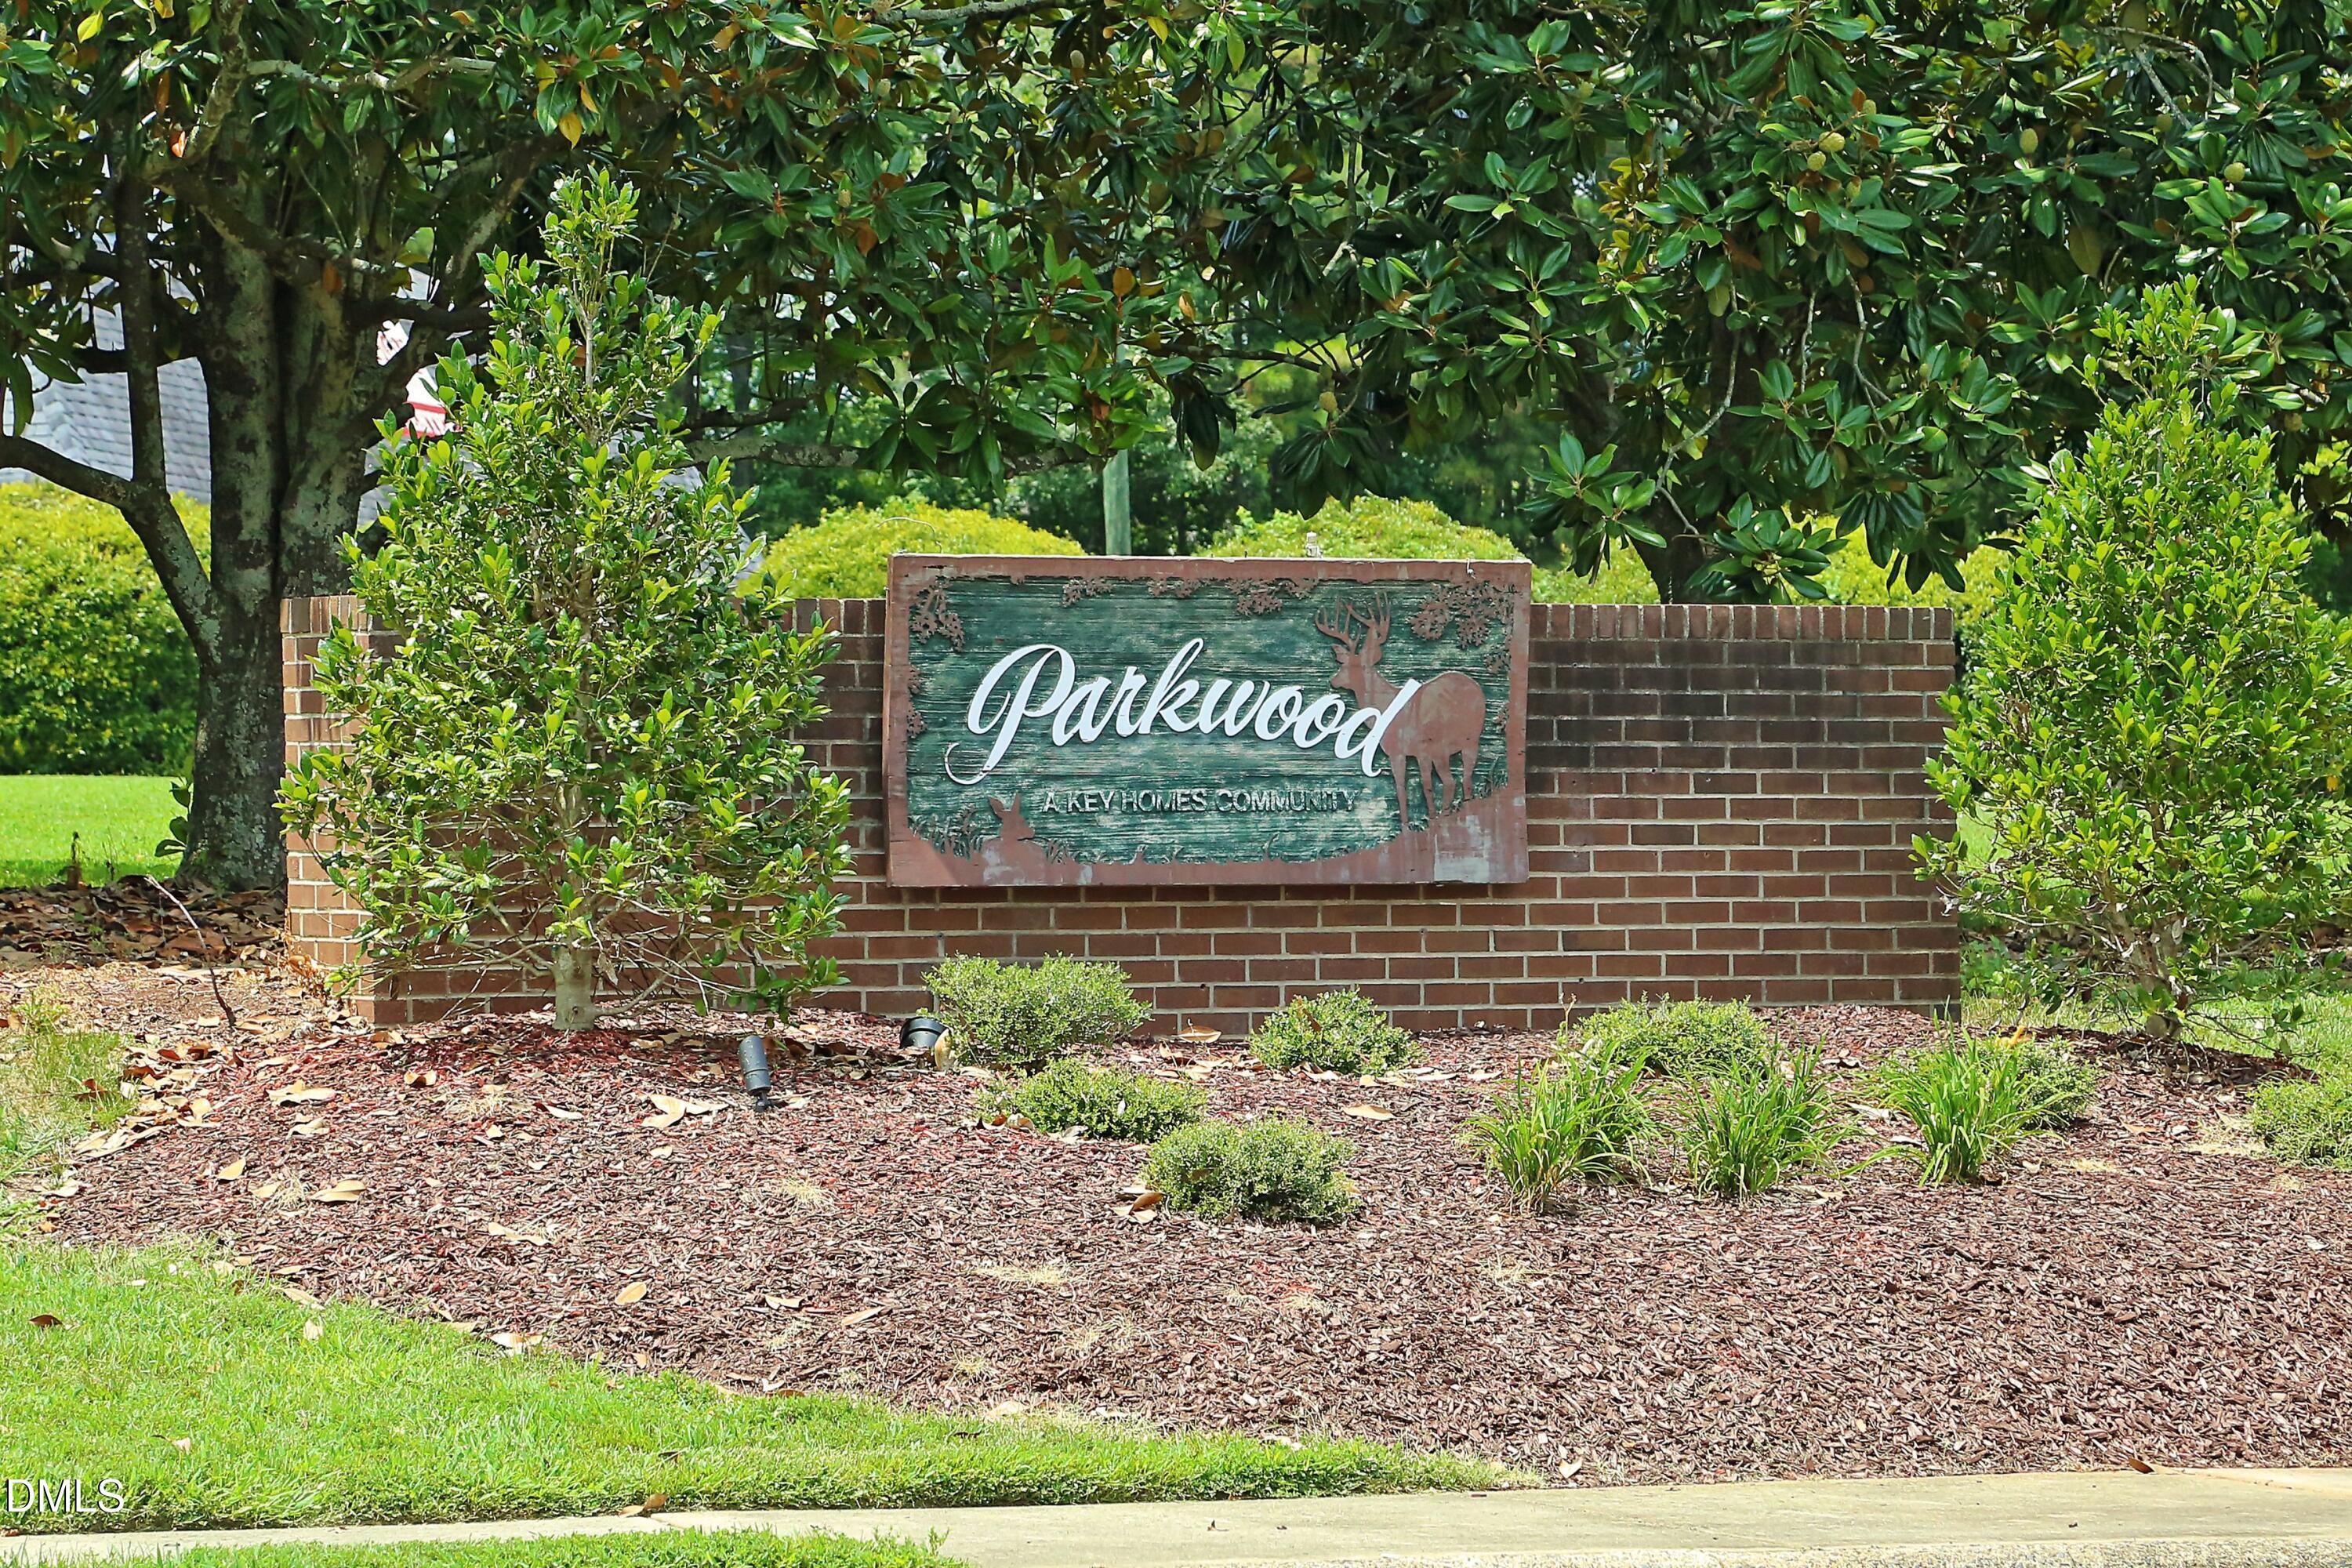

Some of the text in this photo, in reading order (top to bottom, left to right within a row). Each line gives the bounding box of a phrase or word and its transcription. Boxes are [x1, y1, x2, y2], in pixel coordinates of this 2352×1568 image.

[945, 637, 1421, 784] Parkwood
[1043, 789, 1359, 812] A KEY HOMES COMMUNITY
